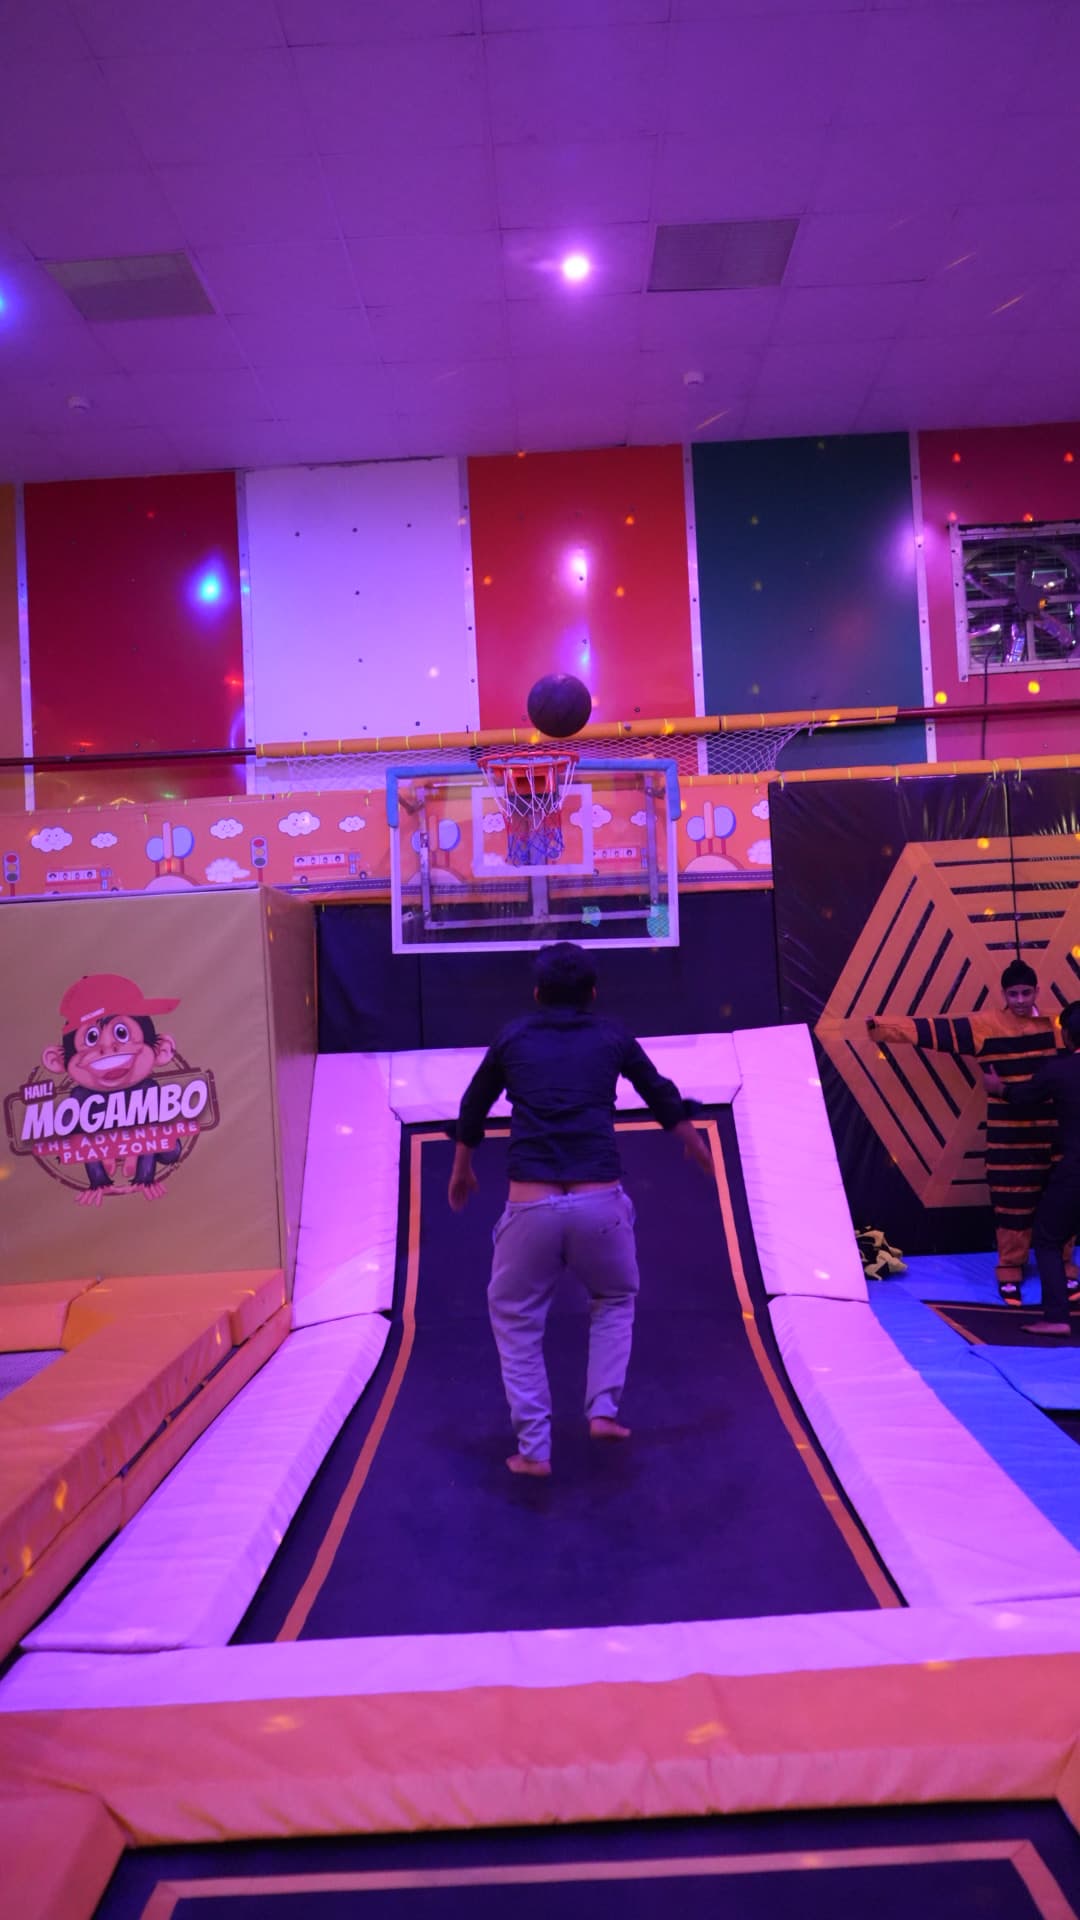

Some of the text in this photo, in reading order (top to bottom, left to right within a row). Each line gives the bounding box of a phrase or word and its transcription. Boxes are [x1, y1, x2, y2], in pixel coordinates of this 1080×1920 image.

[24, 1083, 53, 1100] HAIL!
[21, 1080, 208, 1141] MOGAMBO
[35, 1122, 198, 1153] THE ADVENTURE
[63, 1138, 169, 1163] PLAY ZONE
